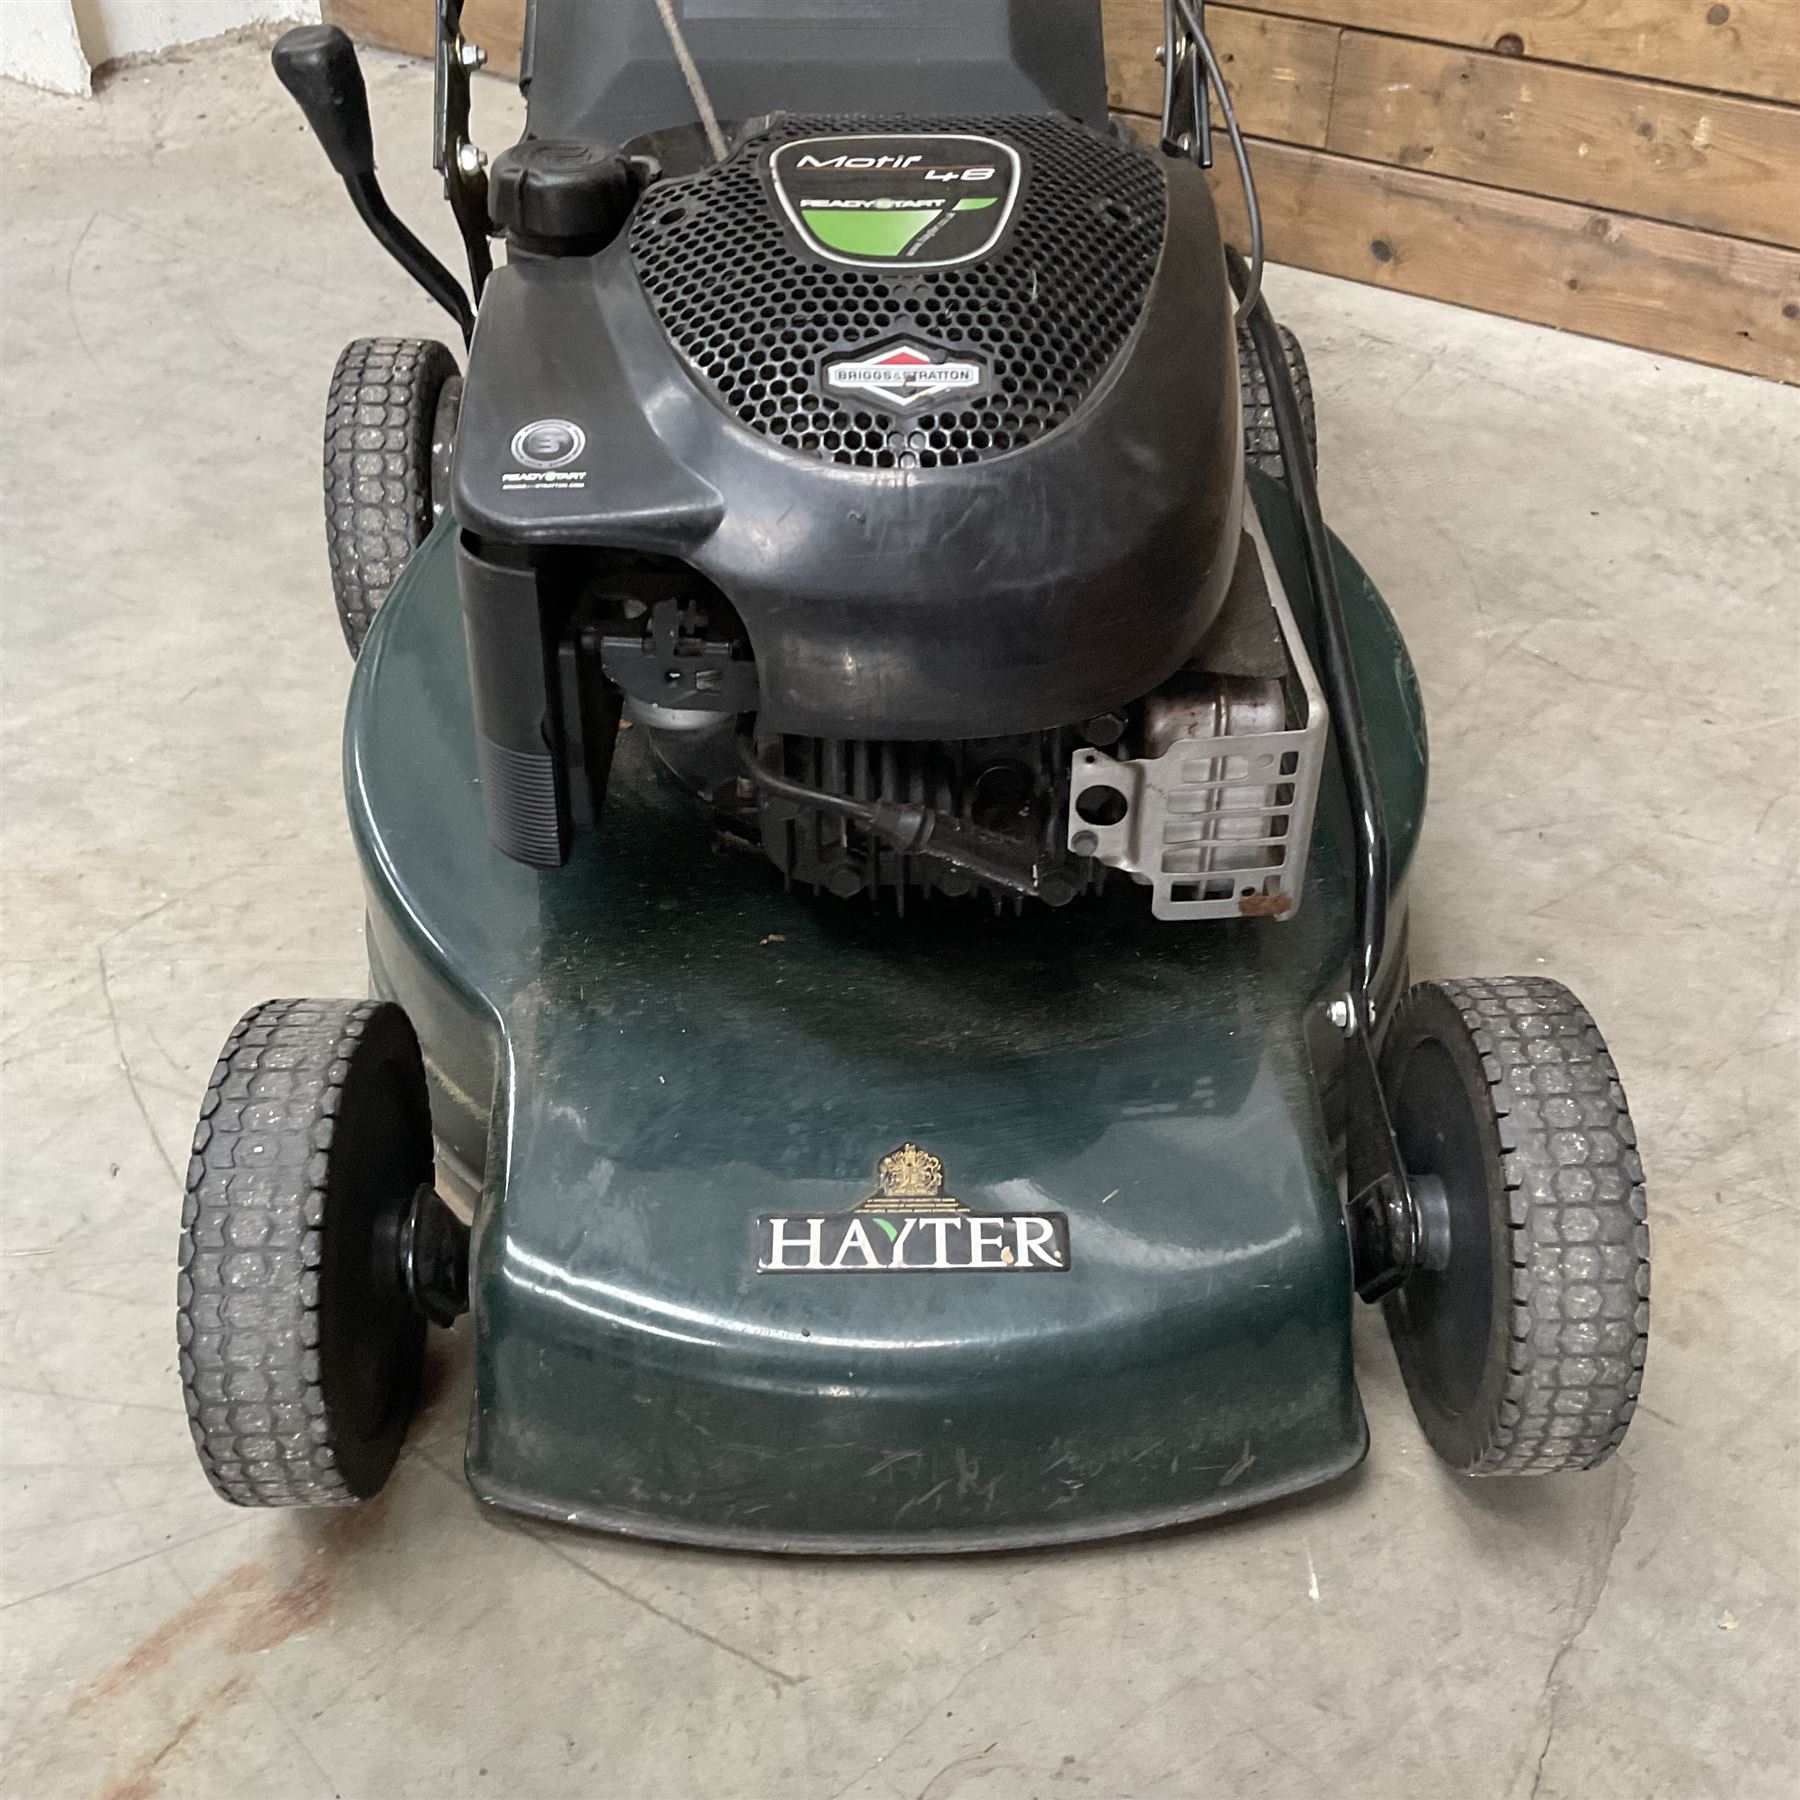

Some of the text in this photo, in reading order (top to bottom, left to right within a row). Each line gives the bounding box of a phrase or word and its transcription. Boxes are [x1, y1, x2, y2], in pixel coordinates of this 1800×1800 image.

[924, 168, 995, 181] 48
[502, 471, 586, 481] READYTART
[768, 1217, 1064, 1269] HAYTER
